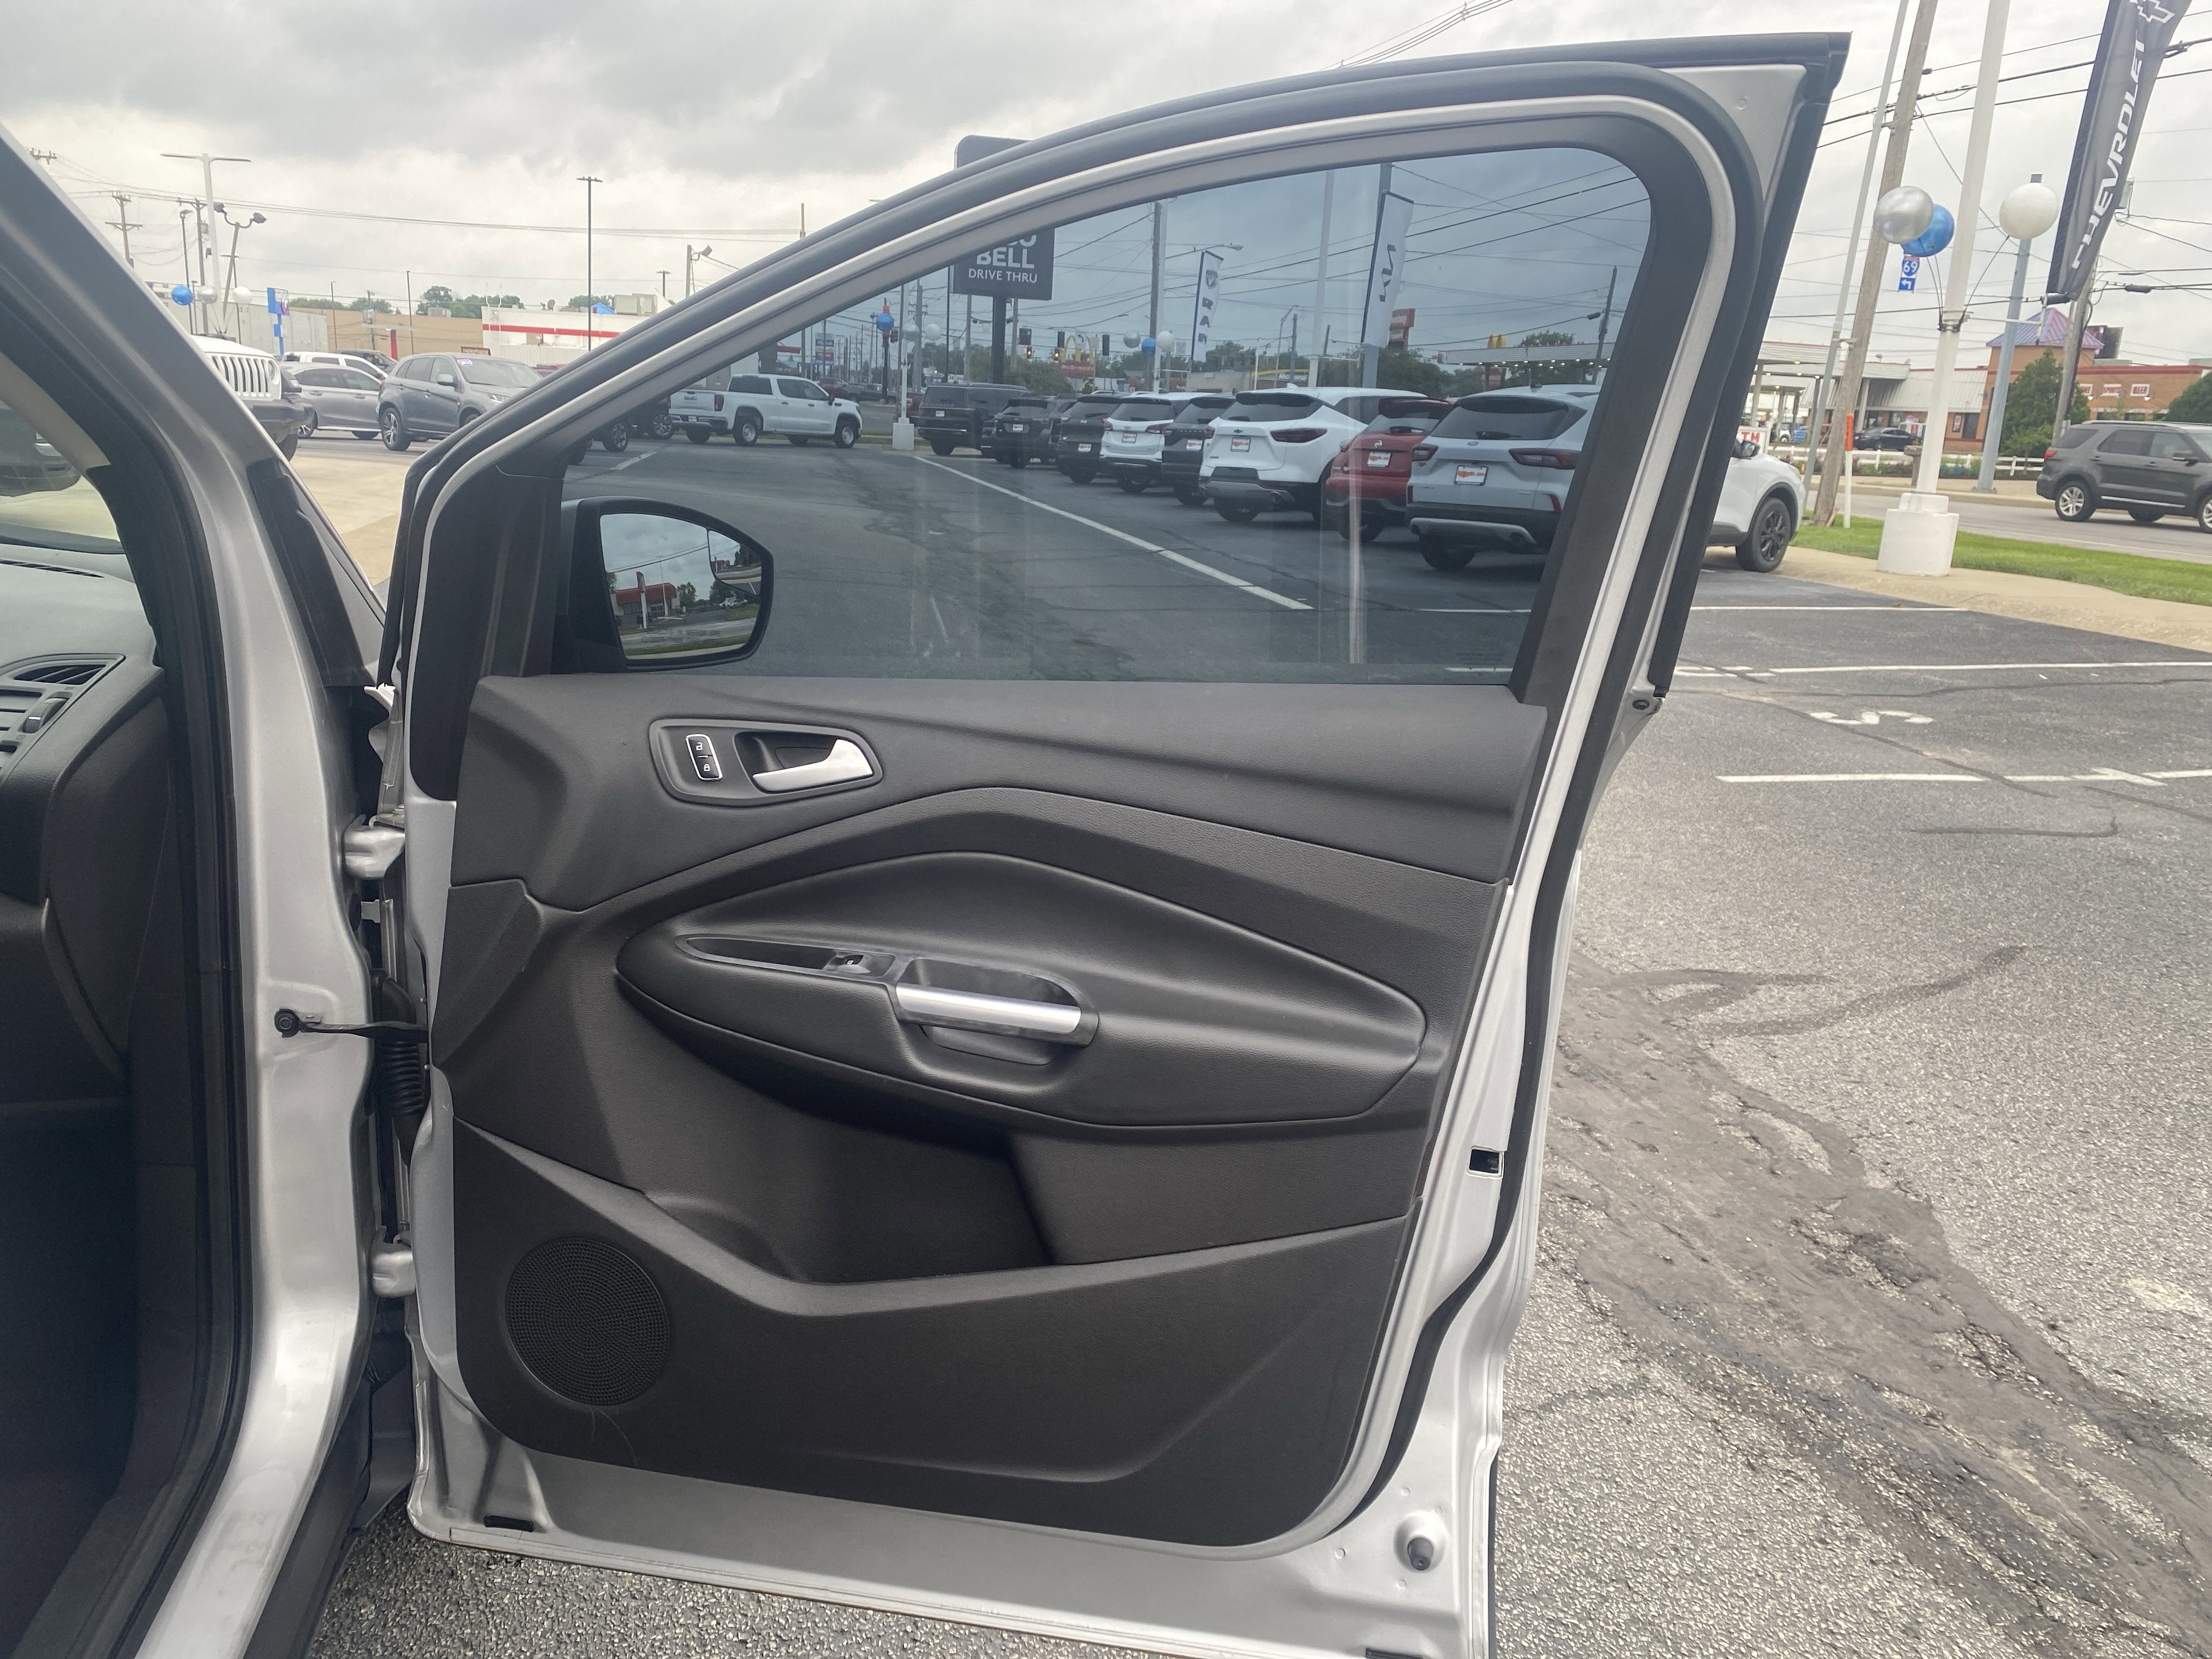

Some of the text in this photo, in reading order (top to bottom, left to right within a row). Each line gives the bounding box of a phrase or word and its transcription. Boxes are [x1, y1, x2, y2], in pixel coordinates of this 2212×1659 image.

[977, 246, 1035, 269] BELL
[1903, 261, 1918, 273] 69
[968, 268, 1037, 283] DRIVE THRU
[1741, 431, 1760, 443] TM
